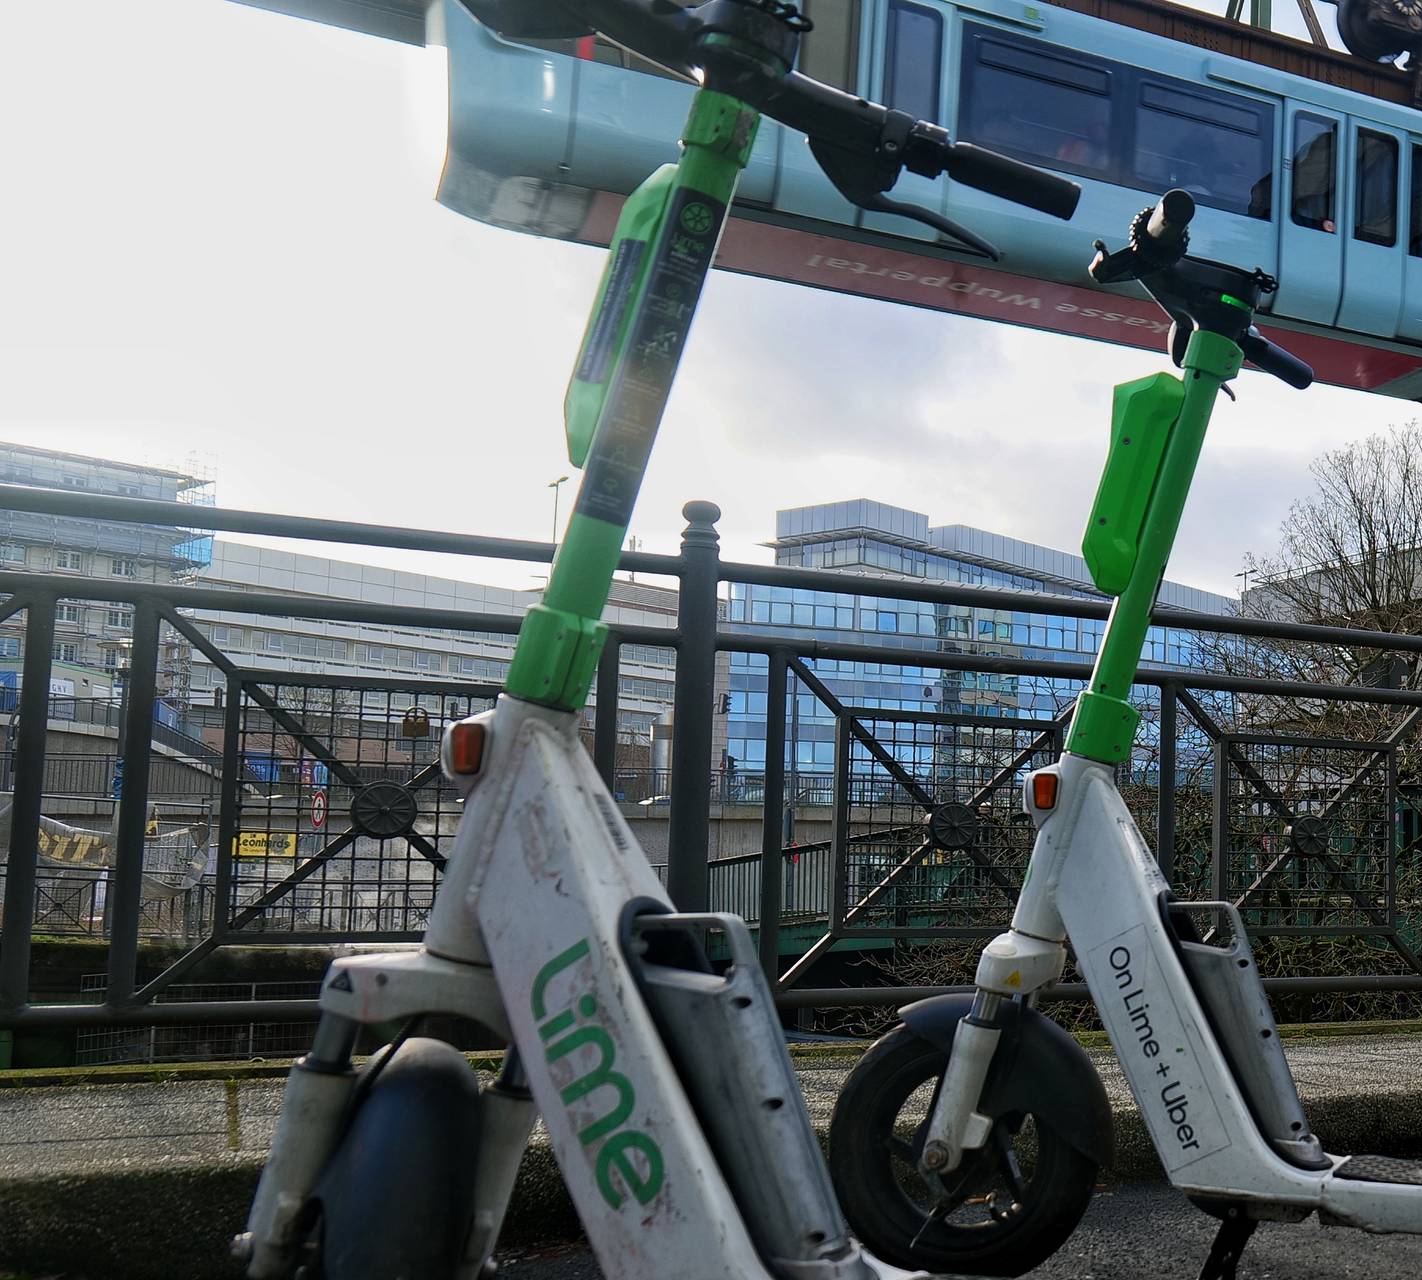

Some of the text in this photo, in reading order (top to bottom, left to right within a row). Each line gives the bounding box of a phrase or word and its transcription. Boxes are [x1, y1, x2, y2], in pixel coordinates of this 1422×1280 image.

[806, 253, 1170, 334] kasse Wuppertal
[237, 838, 292, 849] eonhards
[531, 936, 664, 1211] Lime
[1109, 946, 1200, 1150] On Lime + Uber
